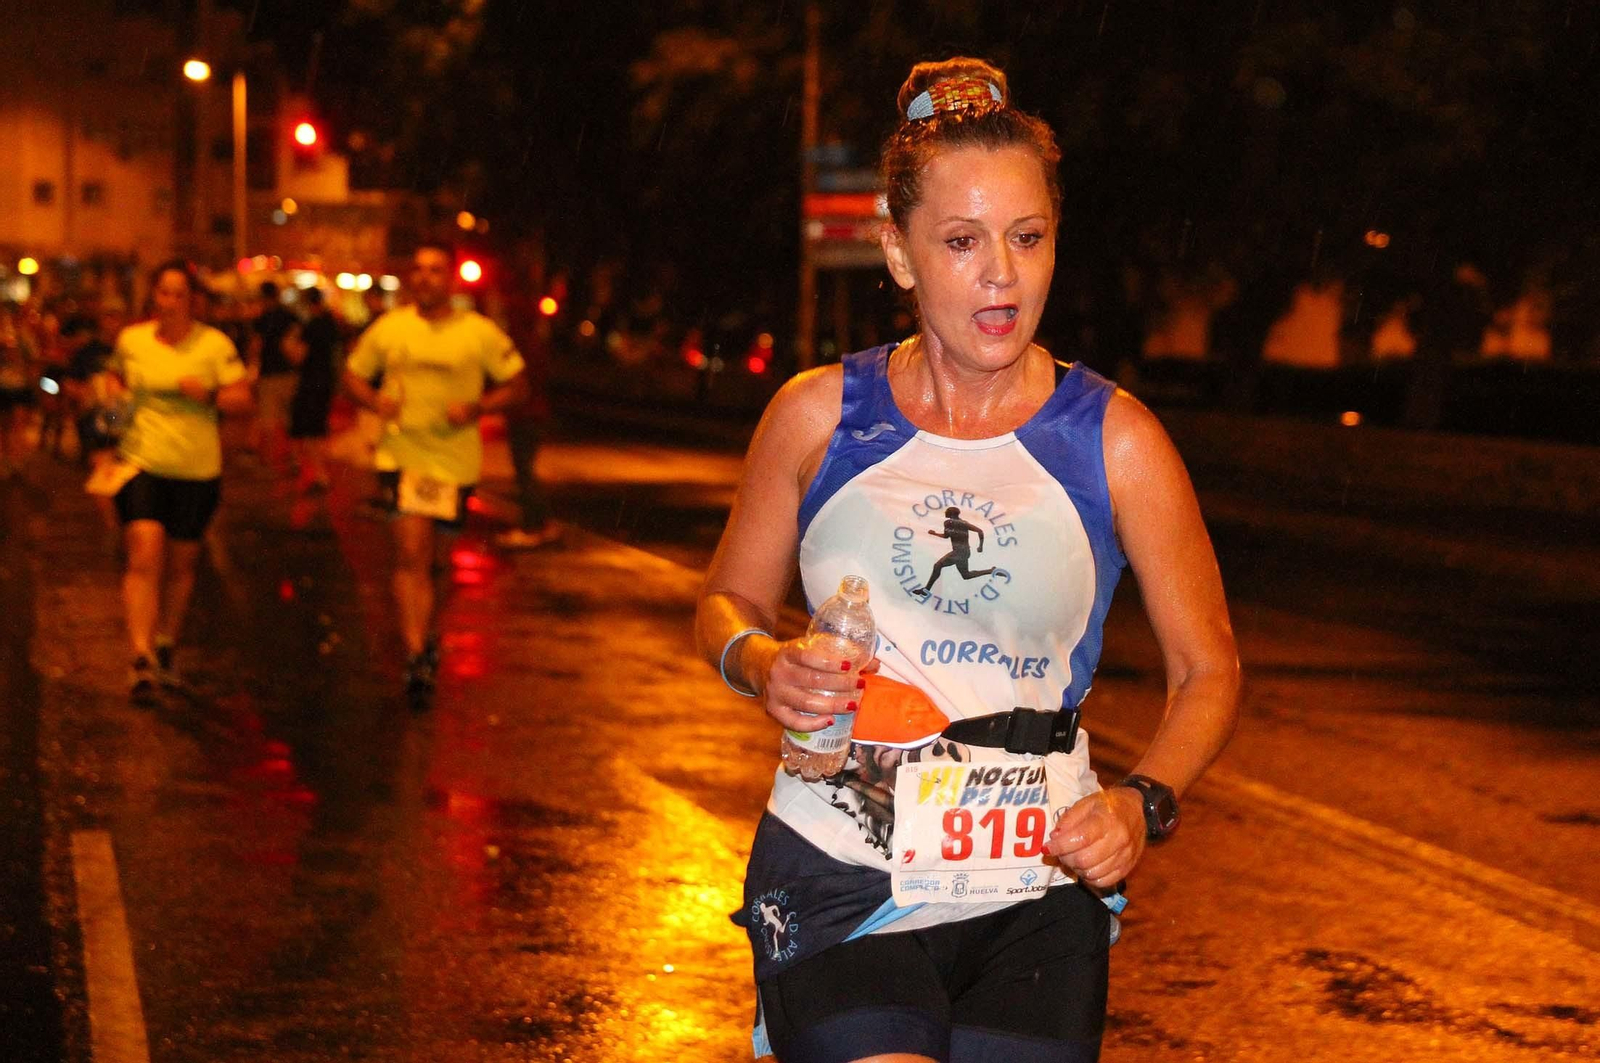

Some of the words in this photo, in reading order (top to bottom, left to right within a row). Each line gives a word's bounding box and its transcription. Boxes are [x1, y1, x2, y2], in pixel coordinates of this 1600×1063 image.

[912, 489, 1017, 548] CORRALES
[892, 526, 970, 615] ATLETISMO
[941, 807, 1047, 861] 819
[970, 887, 999, 895] HUELVA
